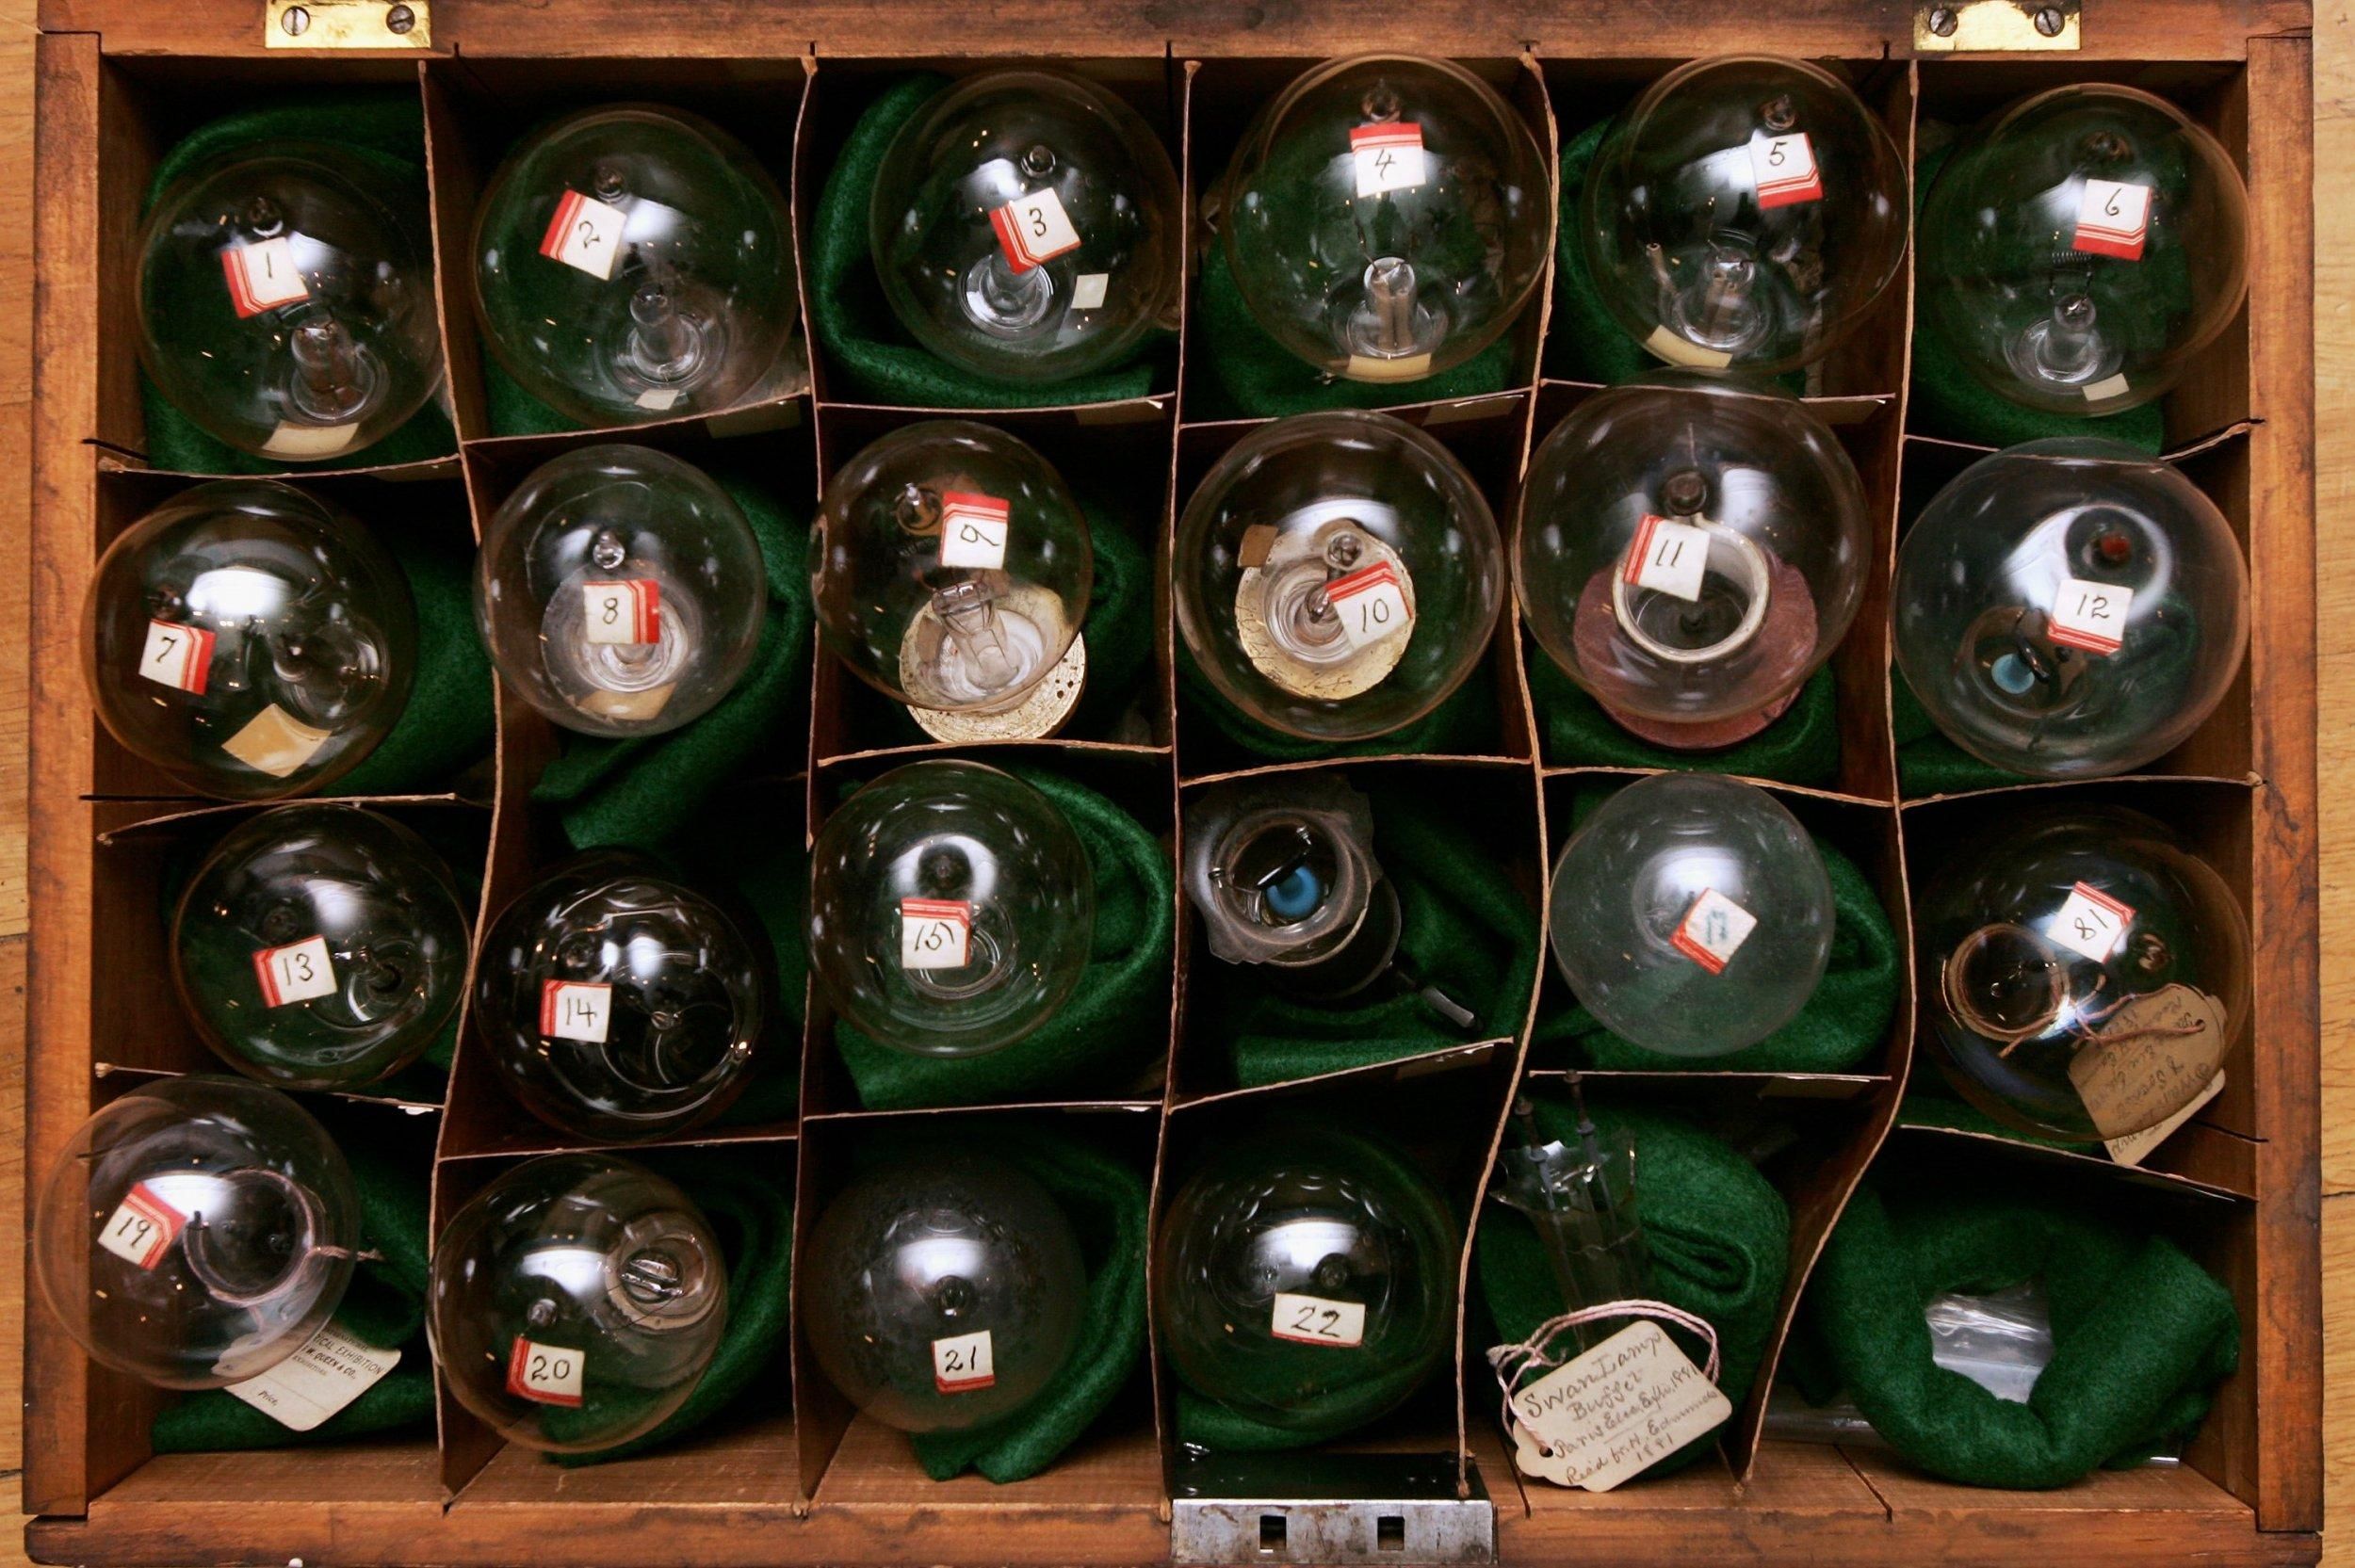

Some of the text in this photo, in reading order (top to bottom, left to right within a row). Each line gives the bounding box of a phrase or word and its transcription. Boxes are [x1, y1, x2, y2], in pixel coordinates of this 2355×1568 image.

[1374, 148, 1396, 181] 4
[1768, 140, 1787, 167] 5
[2104, 187, 2122, 217] 6
[578, 219, 601, 249] 2
[1029, 207, 1048, 237] 3
[266, 251, 273, 280] 1
[960, 523, 1000, 546] 9
[1655, 538, 1684, 569] 11
[602, 597, 619, 625] 8
[1361, 598, 1389, 633] 10
[2076, 592, 2110, 621] 12
[156, 636, 177, 664] 7
[914, 920, 955, 952] 15
[283, 952, 314, 986] 13
[565, 996, 597, 1027] 14
[117, 1216, 152, 1249] 19
[1291, 1305, 1341, 1338] 22
[335, 1346, 385, 1375] EXHIBITION
[530, 1355, 571, 1382] 20
[944, 1345, 977, 1373] 21
[1524, 1374, 1600, 1418] Swan
